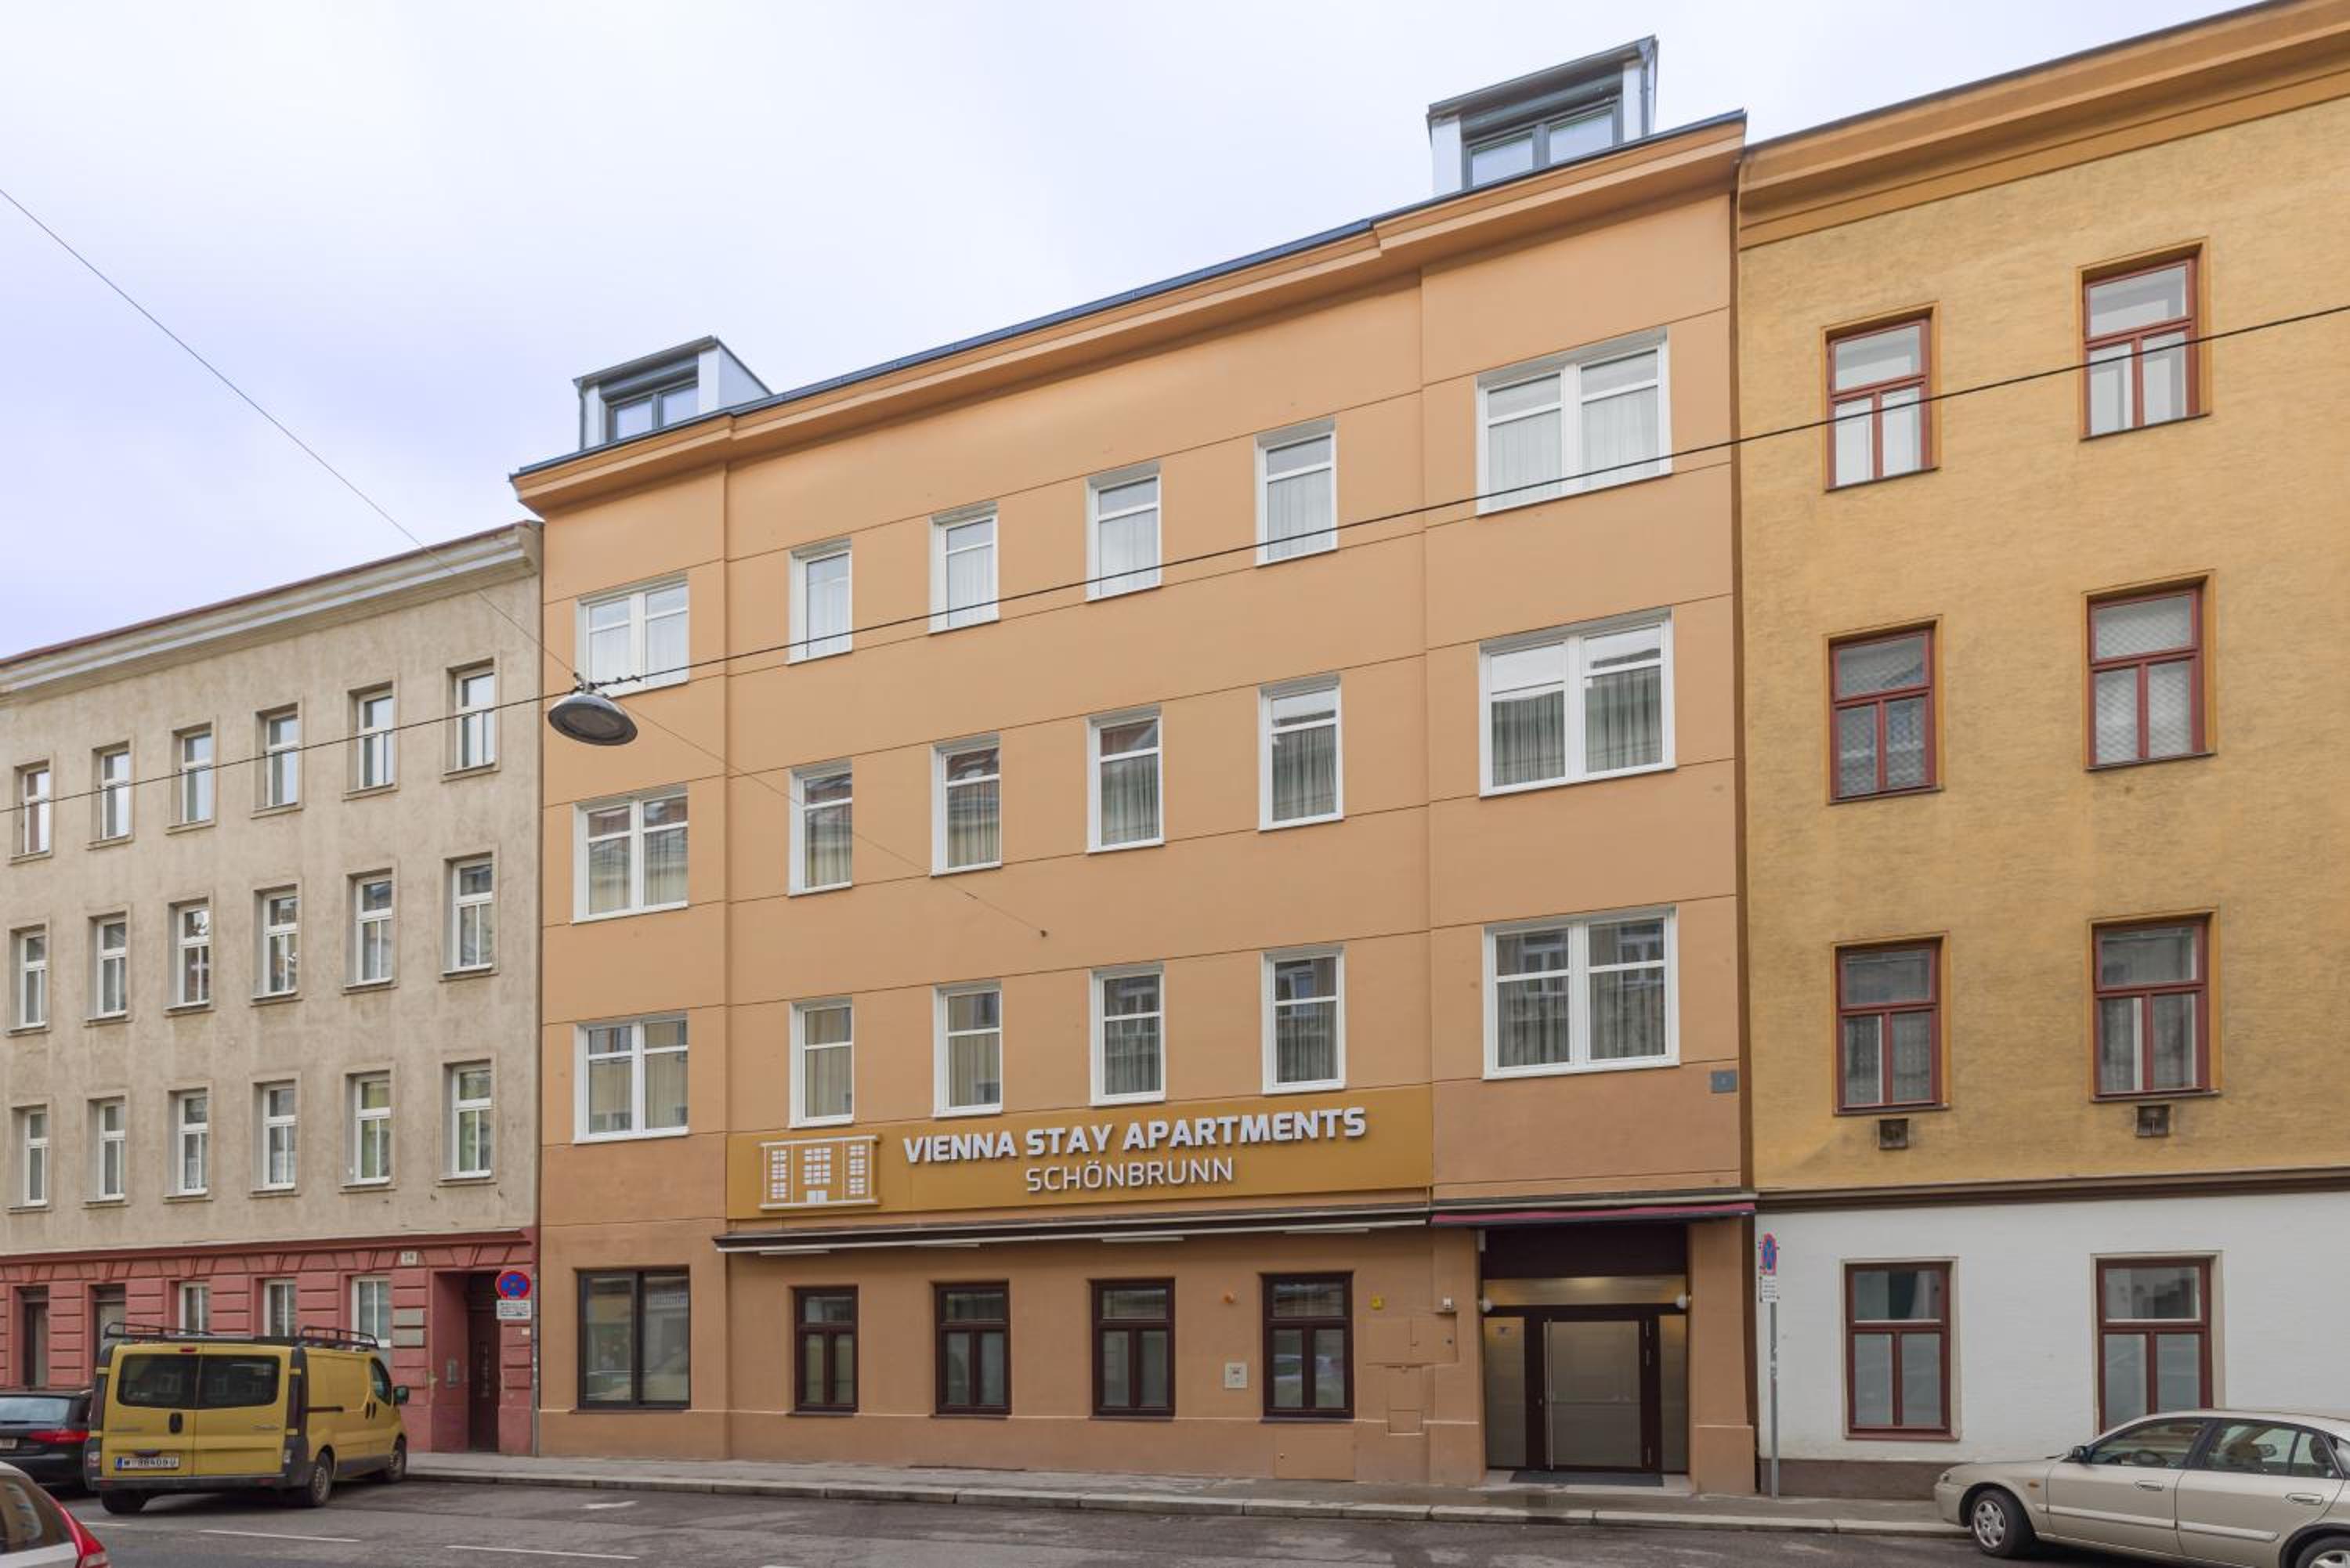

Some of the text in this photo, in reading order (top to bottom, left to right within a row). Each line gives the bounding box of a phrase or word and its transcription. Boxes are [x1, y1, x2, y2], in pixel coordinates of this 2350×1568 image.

[902, 1106, 1366, 1163] VIENNA STAY APARTMENTS
[1025, 1156, 1234, 1192] SCHÖNBRUNN
